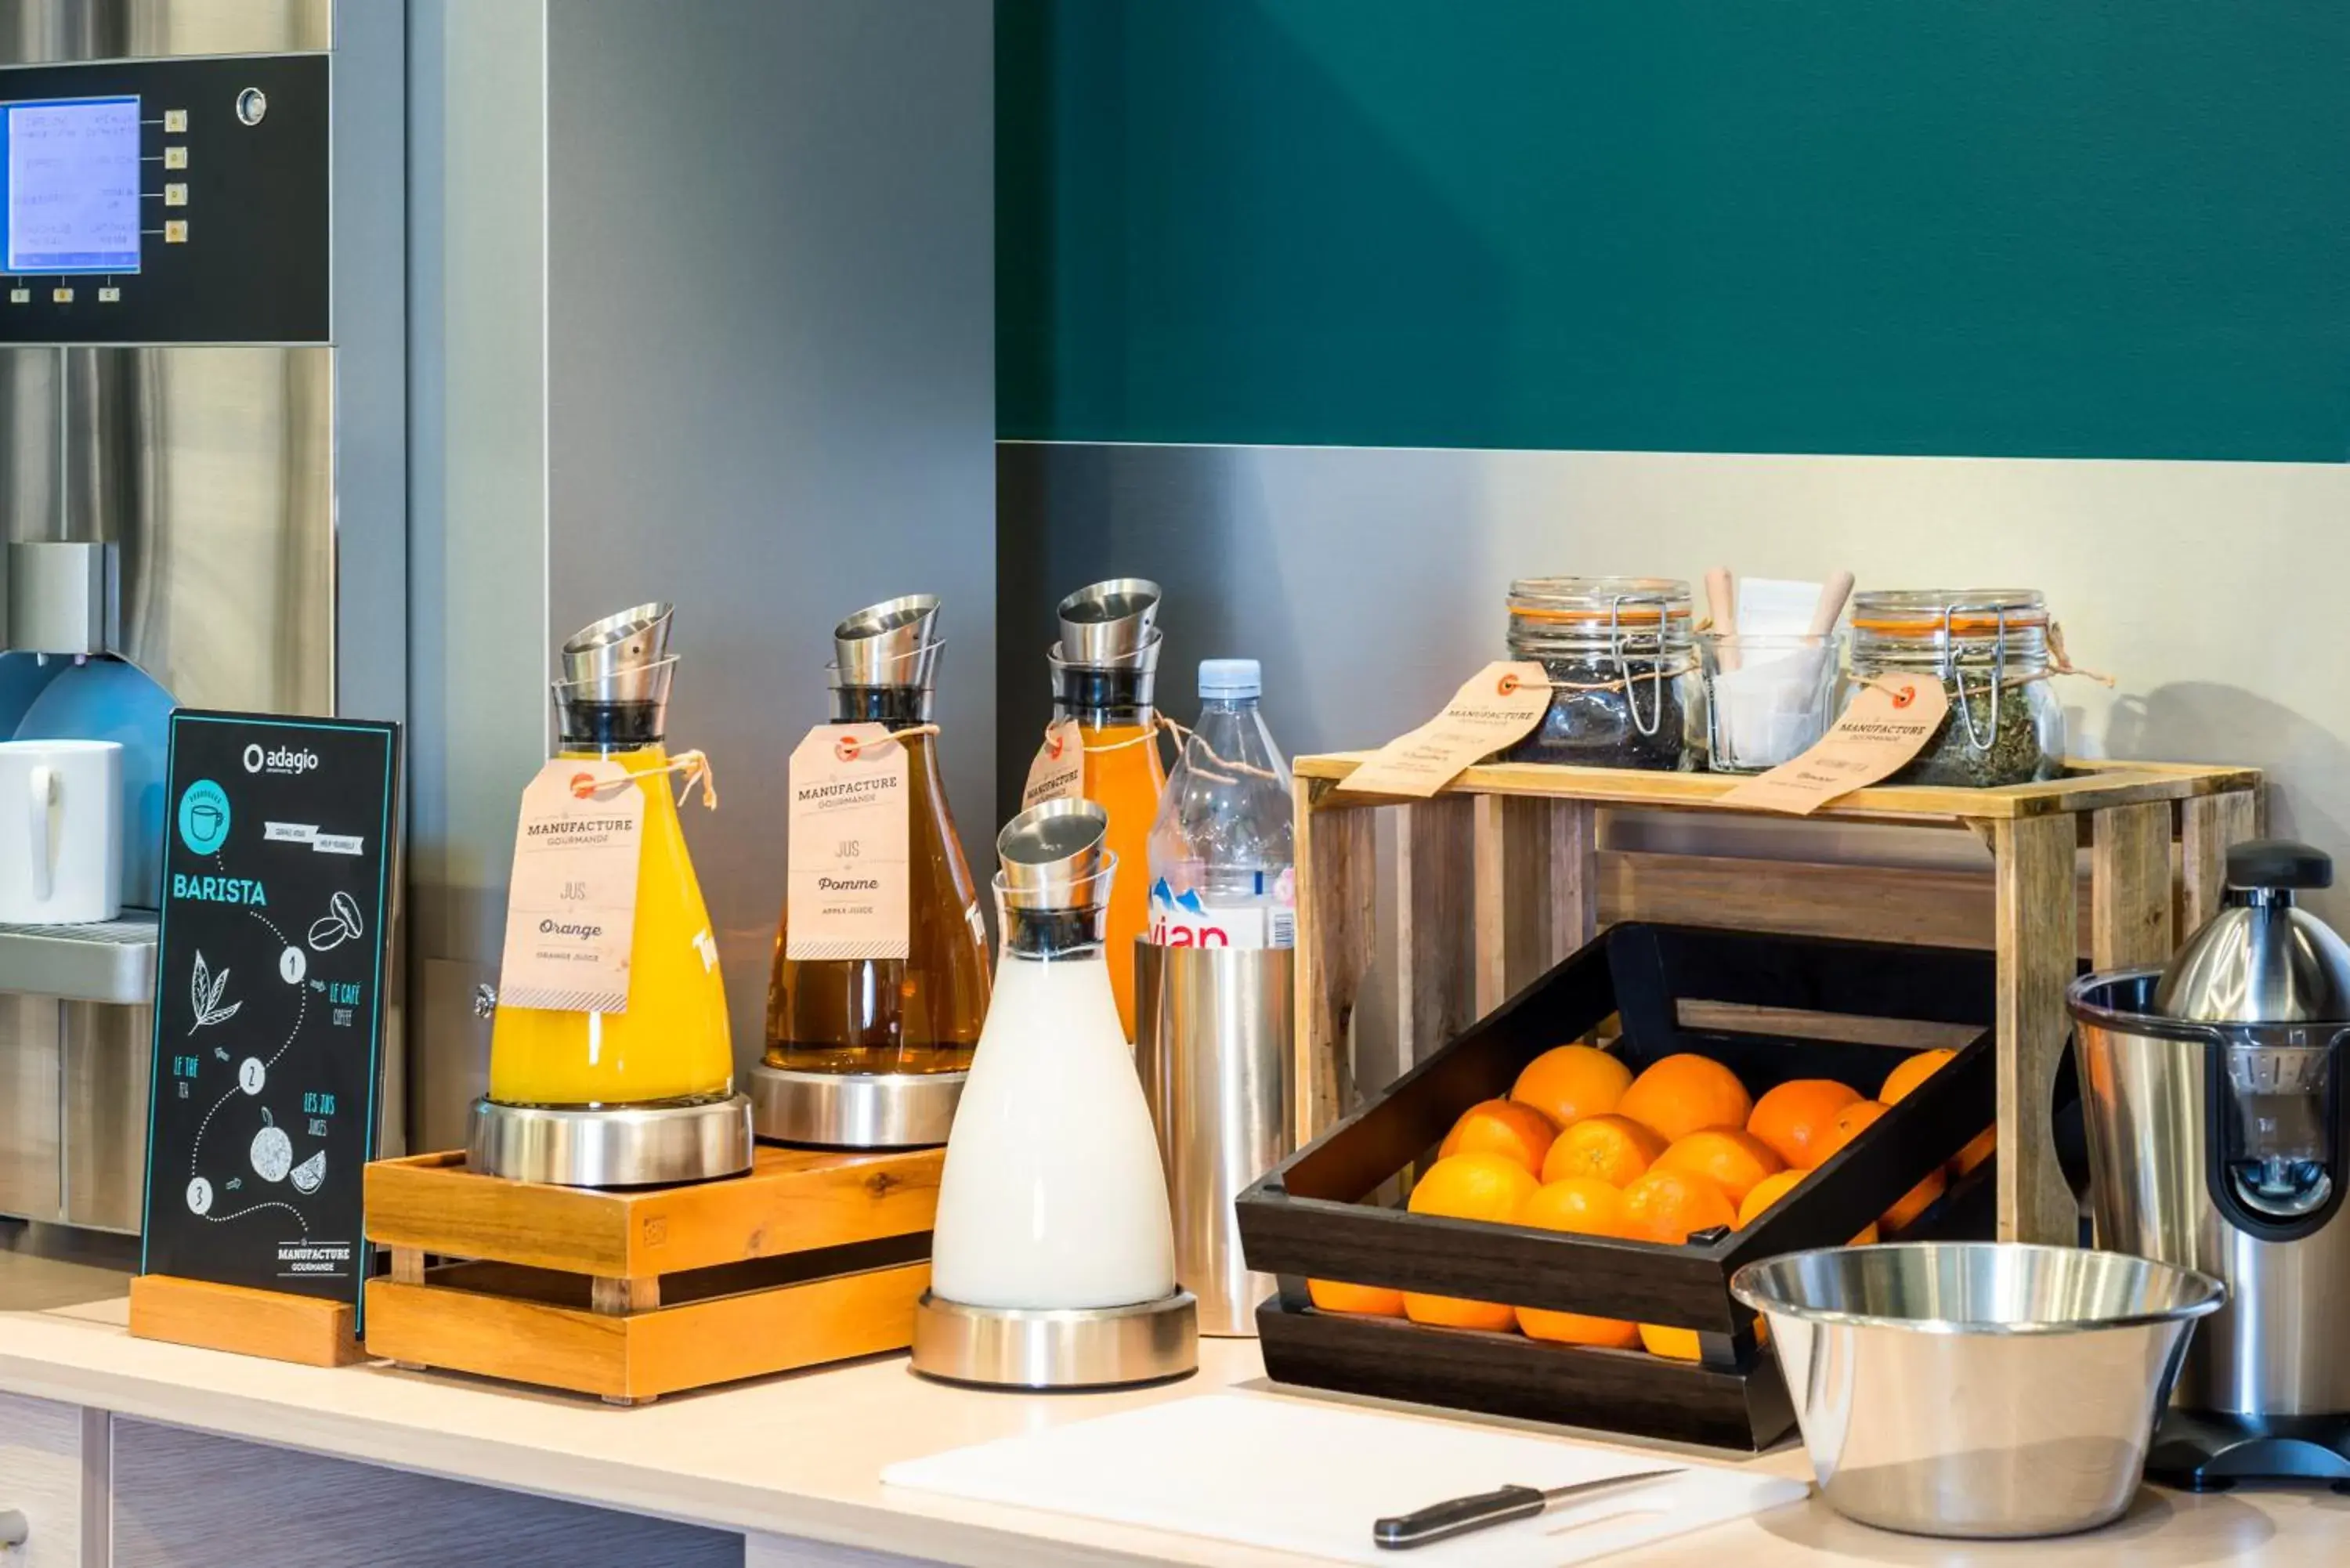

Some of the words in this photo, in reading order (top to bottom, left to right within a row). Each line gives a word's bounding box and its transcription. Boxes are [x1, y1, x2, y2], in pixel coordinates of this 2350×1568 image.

[1448, 710, 1535, 721] MANUFACTURE
[1839, 723, 1926, 736] MANUFACTURE
[266, 745, 319, 775] adagio
[798, 776, 898, 801] MANUFACTURE
[818, 793, 877, 810] GOURMANDE
[527, 820, 633, 836] MANUFACTURE
[547, 834, 609, 846] GOURMANDE
[835, 840, 860, 858] JUS
[173, 873, 266, 906] BARISTA
[560, 882, 586, 900] JUS
[819, 876, 879, 891] Pomme
[539, 919, 602, 940] Orange
[289, 955, 297, 976] 1
[341, 981, 362, 1005] CAFÉ
[173, 1056, 183, 1075] LE
[185, 1054, 199, 1078] THÉ
[248, 1067, 255, 1086] 2
[304, 1092, 317, 1113] LES
[320, 1093, 334, 1115] JUS
[195, 1187, 203, 1207] 3
[277, 1248, 350, 1260] MANUFACTURE
[291, 1262, 334, 1271] GOURMANDE
